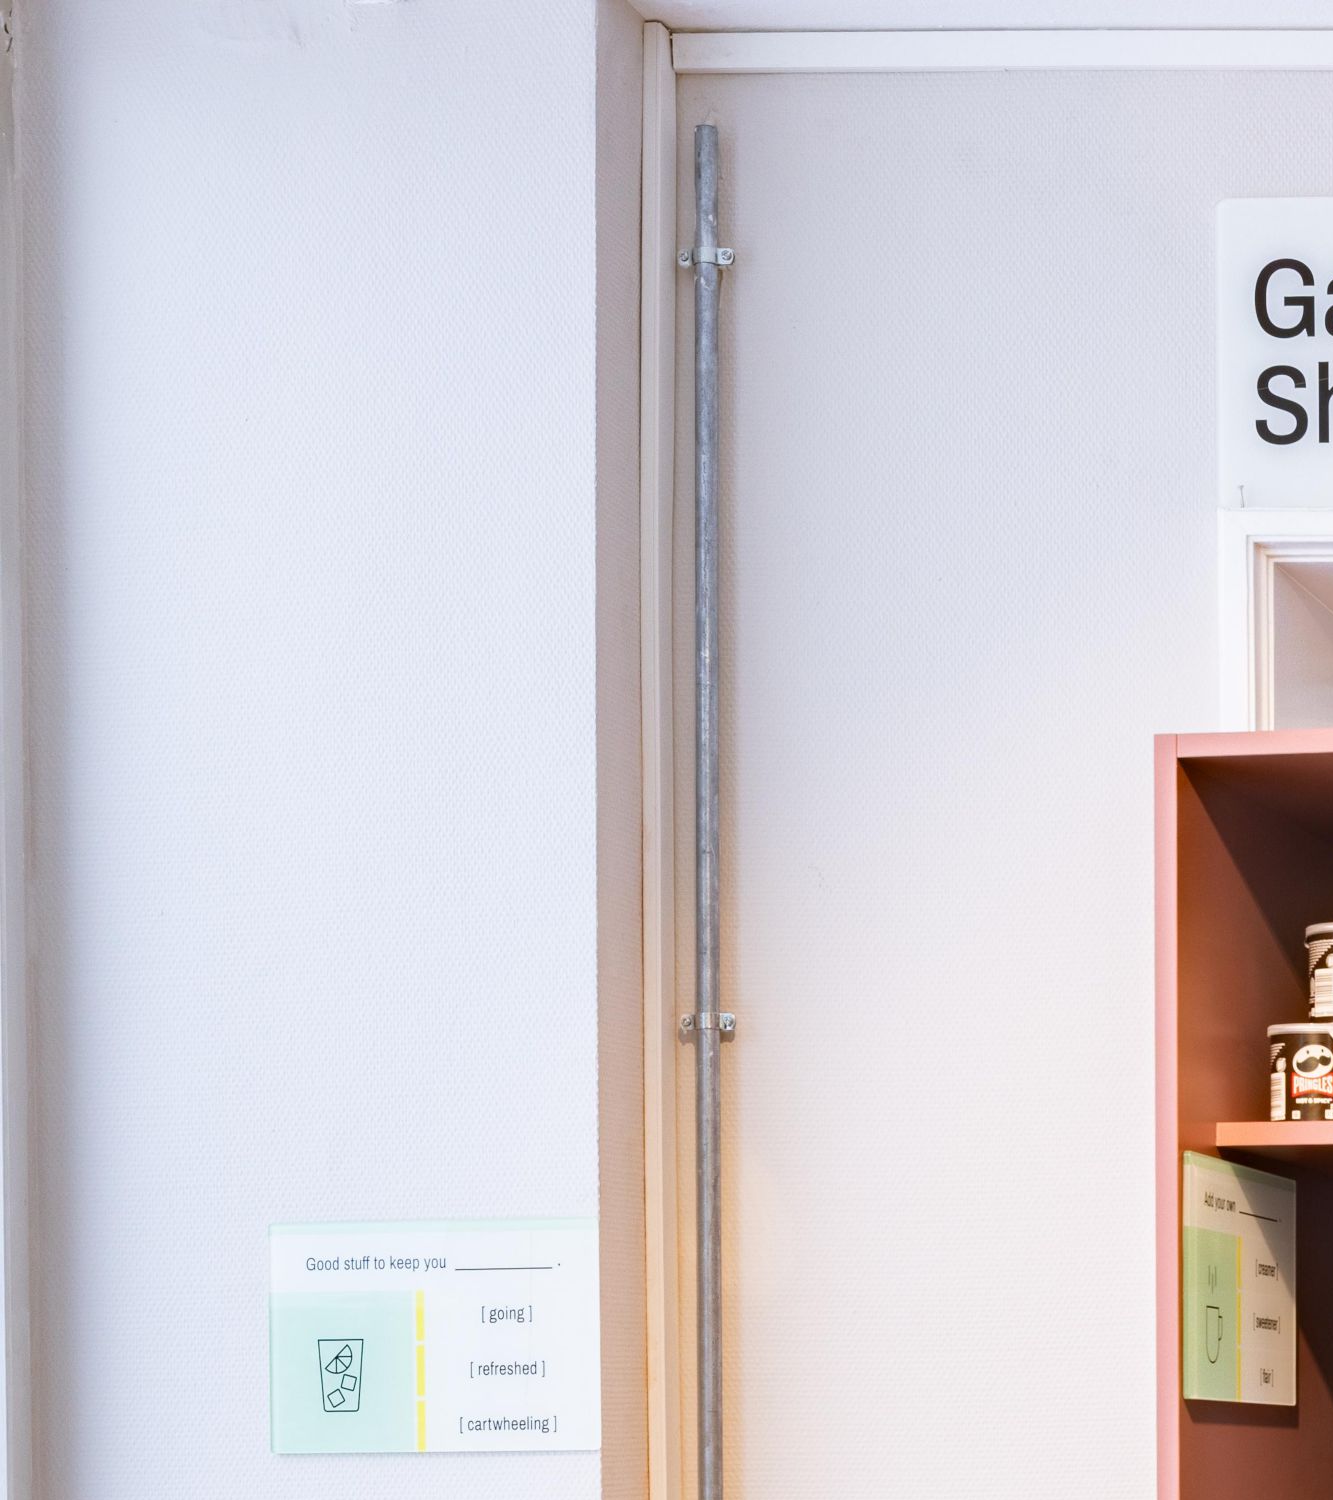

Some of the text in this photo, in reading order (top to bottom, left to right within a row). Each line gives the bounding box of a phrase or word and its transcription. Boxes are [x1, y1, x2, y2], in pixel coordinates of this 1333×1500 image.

[1293, 1074, 1333, 1096] PRINGLES
[306, 1256, 446, 1272] Good stuff to keep you
